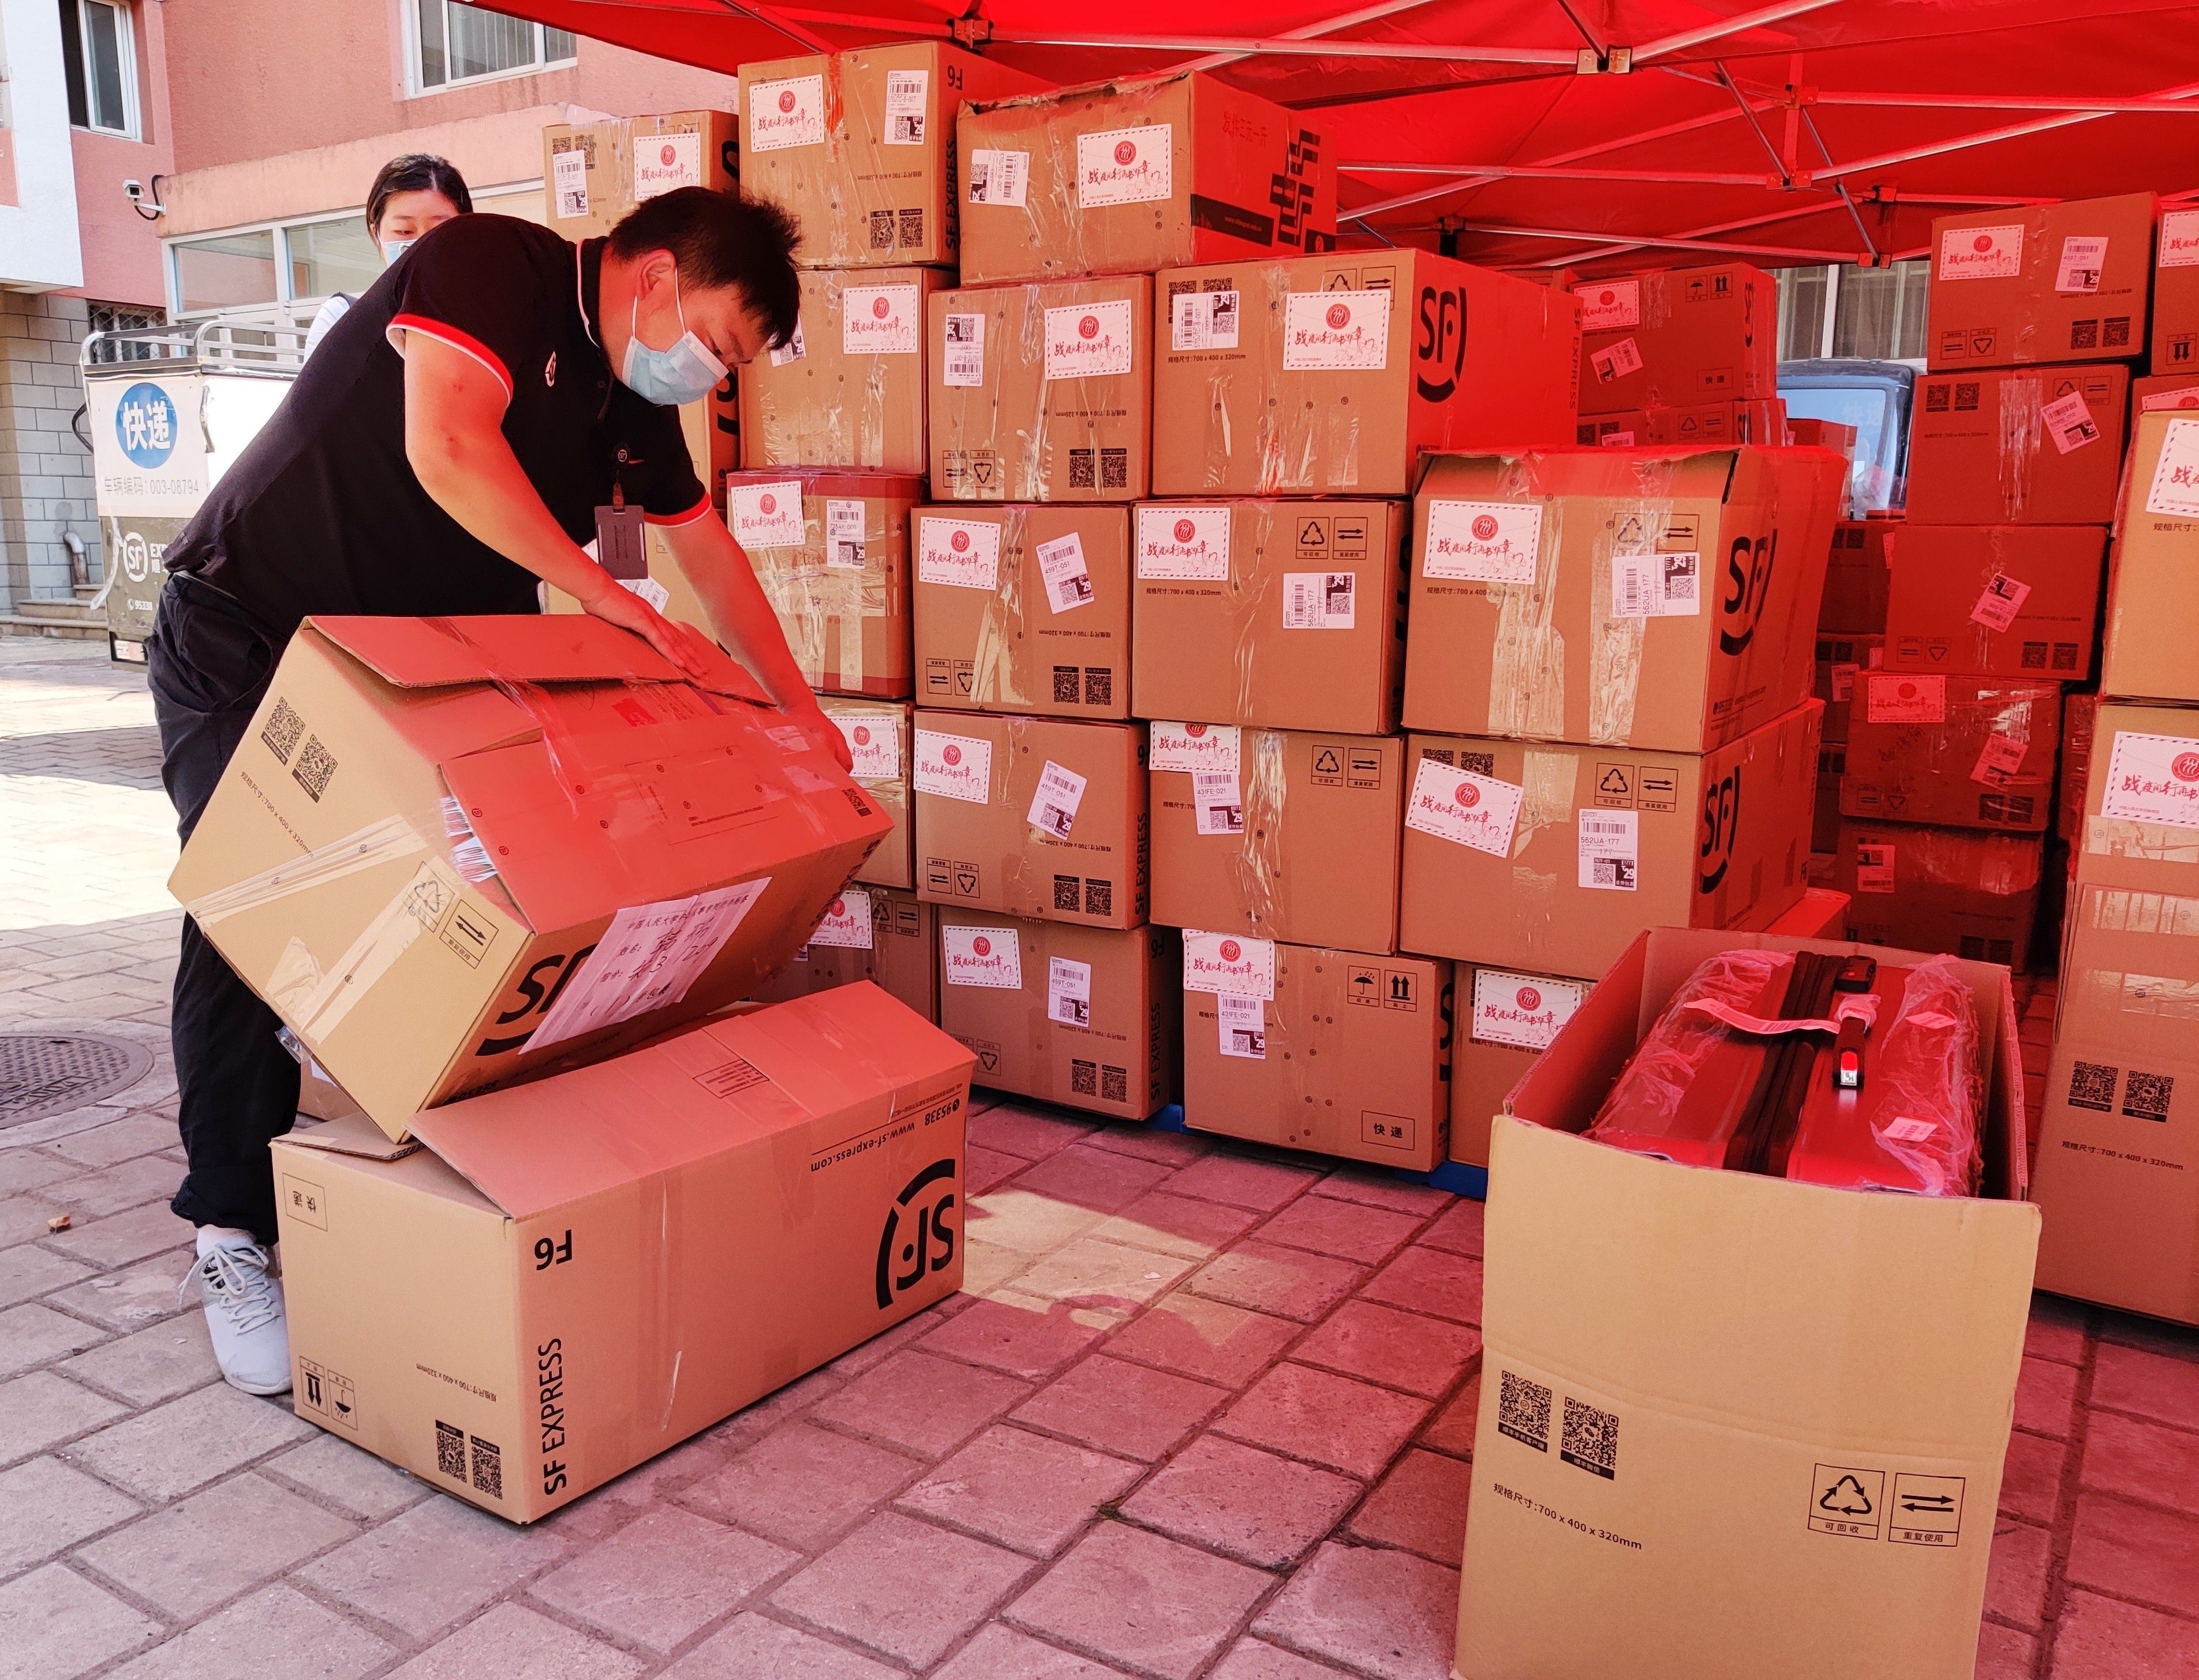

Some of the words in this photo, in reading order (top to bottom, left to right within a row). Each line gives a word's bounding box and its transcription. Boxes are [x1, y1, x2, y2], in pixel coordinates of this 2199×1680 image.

[1705, 375, 1725, 384] 快递
[122, 401, 170, 452] 快递
[1045, 562, 1071, 574] 459T-051
[1642, 574, 1650, 615] 562UA-177
[1041, 783, 1066, 799] 459T-051
[278, 815, 290, 830] 400
[1135, 811, 1148, 887] EXPRESS
[1580, 836, 1620, 845] 562UA-177
[1135, 892, 1146, 916] SF
[1051, 978, 1076, 989] 459T-051
[925, 1102, 951, 1126] 95338
[1373, 1123, 1403, 1139] 快递
[810, 1122, 915, 1173] www.sf-express.com
[2125, 1154, 2140, 1162] 400
[2150, 1158, 2183, 1170] 320mm
[293, 1191, 316, 1214] 快递
[533, 1229, 573, 1271] F6
[537, 1338, 566, 1454] EXPRESS
[1574, 1458, 1600, 1473] 顺丰微信
[543, 1461, 567, 1496] SF
[1568, 1518, 1586, 1532] 400
[1598, 1529, 1641, 1550] 320mm
[1825, 1522, 1859, 1534] 可回收
[1903, 1532, 1943, 1543] 重复使用
